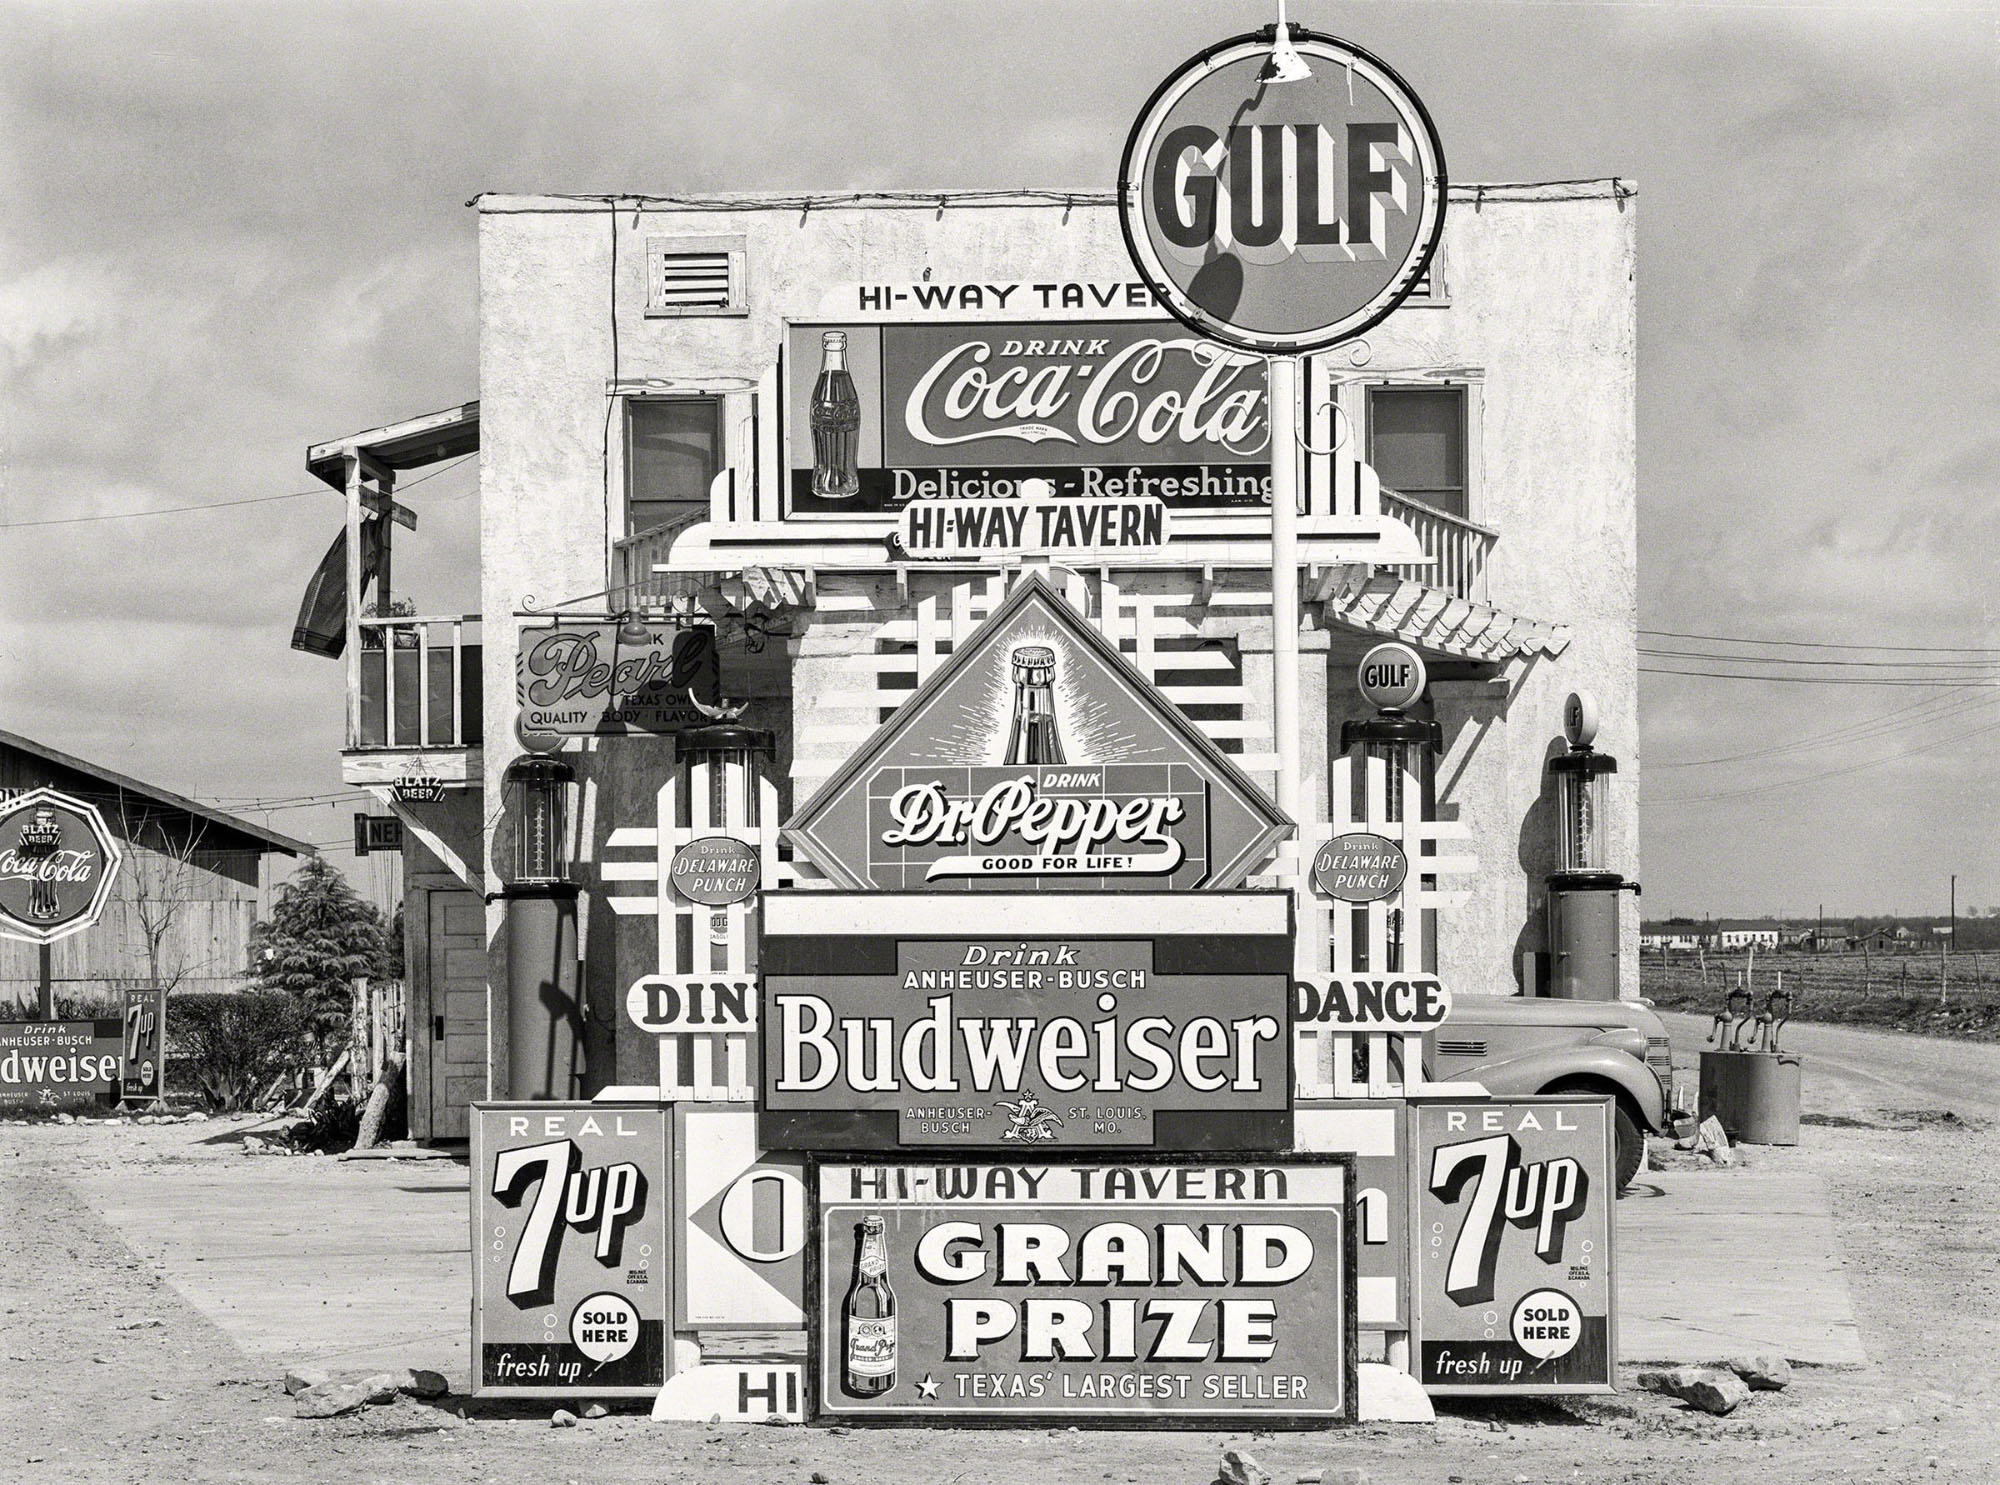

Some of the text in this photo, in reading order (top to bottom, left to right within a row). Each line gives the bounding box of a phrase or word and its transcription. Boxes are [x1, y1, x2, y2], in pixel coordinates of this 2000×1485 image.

[1153, 122, 1413, 264] GULF
[859, 282, 1172, 311] HI-WAY TAVER
[1000, 338, 1110, 357] DRINK
[905, 338, 1264, 446] Coca-Cola
[1081, 467, 1271, 504] Refreshing
[1036, 503, 1163, 548] TAVERN
[528, 630, 709, 707] Pearl
[1364, 663, 1411, 688] GULF
[530, 711, 588, 725] QUALITY
[602, 710, 641, 723] BODY
[394, 776, 442, 787] BLATZ
[1043, 772, 1102, 788] DRINK
[402, 788, 434, 799] BEER
[22, 824, 60, 834] BLATZ
[28, 835, 53, 843] BEER
[1343, 841, 1379, 851] Drink
[701, 845, 737, 854] Drink
[673, 857, 755, 875] DELAWARE
[982, 858, 1033, 870] GOOD
[1042, 857, 1077, 869] FOR
[1317, 852, 1400, 872] DELAWARE
[692, 877, 747, 892] PUNCH
[1334, 873, 1390, 889] PUNCH
[960, 943, 1081, 966] Drink
[902, 970, 1147, 990] ANHEUSER-BUSCH
[130, 994, 155, 1003] REAL
[642, 982, 758, 1025] DIN
[1294, 980, 1446, 1023] DANCE
[24, 1024, 67, 1035] Drink
[775, 993, 1280, 1093] Budweiser
[0, 1047, 123, 1084] dweise
[906, 1107, 993, 1119] ANHEUSER-
[1068, 1107, 1090, 1119] ST.
[1447, 1110, 1578, 1132] REAL
[510, 1116, 638, 1137] REAL
[921, 1122, 971, 1134] BUSCH
[1093, 1122, 1122, 1134] MO.
[850, 1167, 1048, 1200] HI-WAY
[914, 1219, 1315, 1287] GRAND
[582, 1311, 628, 1325] SOLD
[1523, 1308, 1570, 1322] SOLD
[582, 1329, 629, 1343] HERE
[943, 1297, 1279, 1363] PRIZE
[1523, 1326, 1571, 1340] HERE
[496, 1353, 581, 1382] fresh up
[1435, 1351, 1523, 1380] fresh up
[953, 1371, 1309, 1400] TEXAS' LARGEST SELLER
